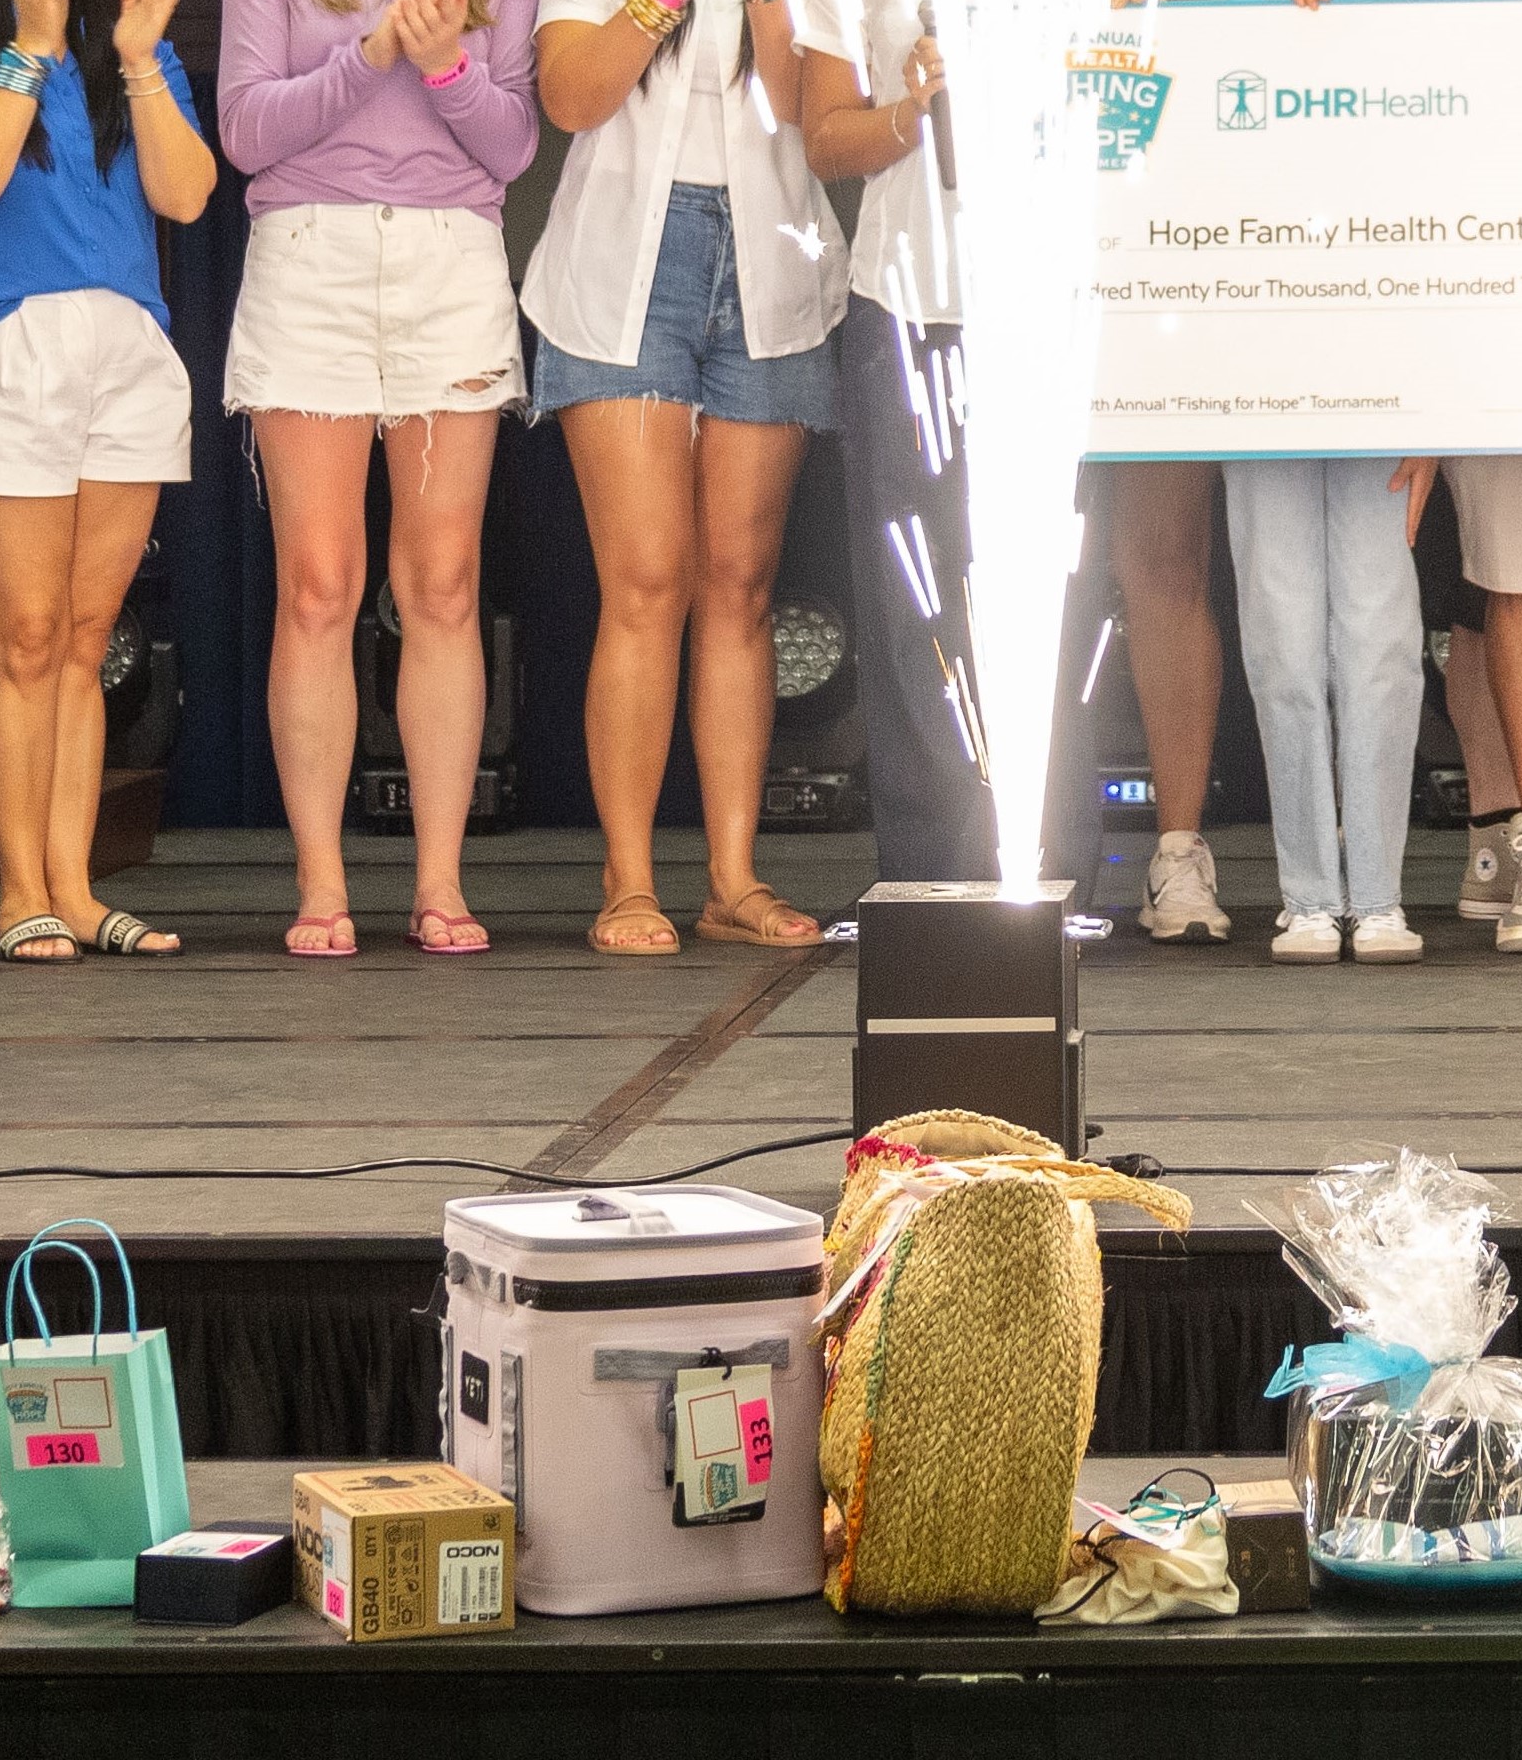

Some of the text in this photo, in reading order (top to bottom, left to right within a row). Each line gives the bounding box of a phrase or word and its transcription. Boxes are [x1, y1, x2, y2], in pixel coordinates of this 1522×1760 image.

[1275, 85, 1469, 119] DHRHealth
[1098, 236, 1122, 252] OF
[1149, 219, 1230, 250] Hope
[1348, 216, 1447, 242] Health
[1137, 280, 1210, 303] Twenty
[1216, 280, 1261, 299] Four
[1265, 278, 1372, 300] Thousand,
[1377, 277, 1421, 296] One
[1426, 275, 1516, 295] Hundred
[1113, 396, 1167, 411] Annual
[1234, 395, 1255, 410] for
[1309, 394, 1400, 410] Tournament
[44, 1442, 85, 1465] 130
[750, 1417, 773, 1465] 133
[446, 1545, 500, 1559] NOCO
[361, 1577, 380, 1635] GB40
